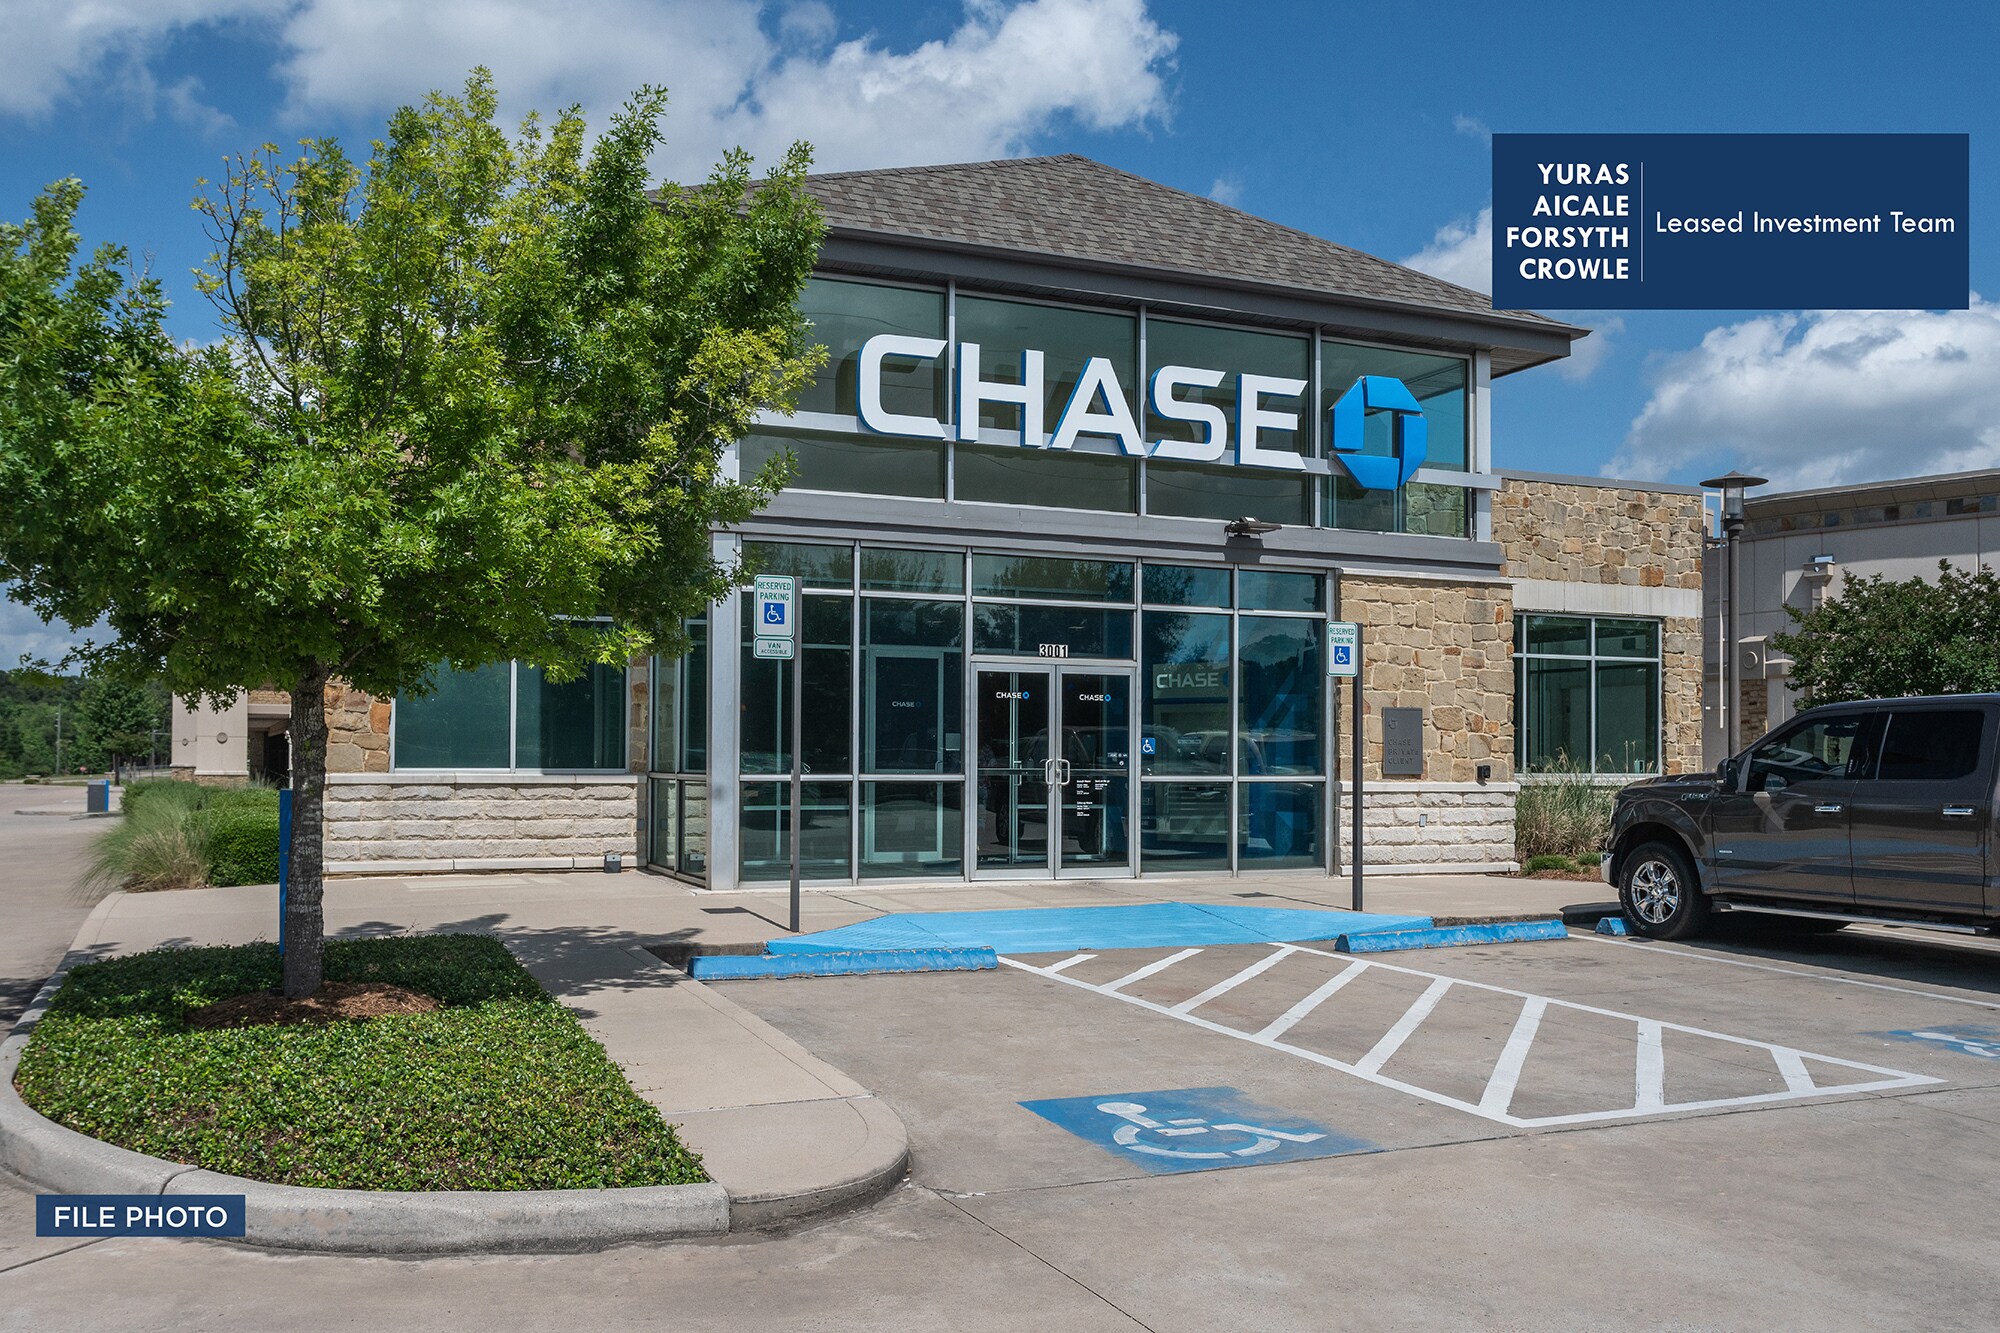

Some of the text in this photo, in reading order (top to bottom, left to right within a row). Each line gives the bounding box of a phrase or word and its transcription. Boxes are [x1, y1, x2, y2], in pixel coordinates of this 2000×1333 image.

[857, 334, 1308, 471] CHASE
[757, 581, 792, 591] RESERVED
[759, 591, 790, 601] PARKING
[1329, 627, 1355, 636] RESERVED
[1331, 636, 1354, 645] PARKING
[1040, 644, 1067, 658] 3001
[1156, 672, 1220, 688] CHASE
[995, 691, 1022, 699] CHASE
[1079, 693, 1104, 701] CHASE
[891, 700, 915, 708] CHASE
